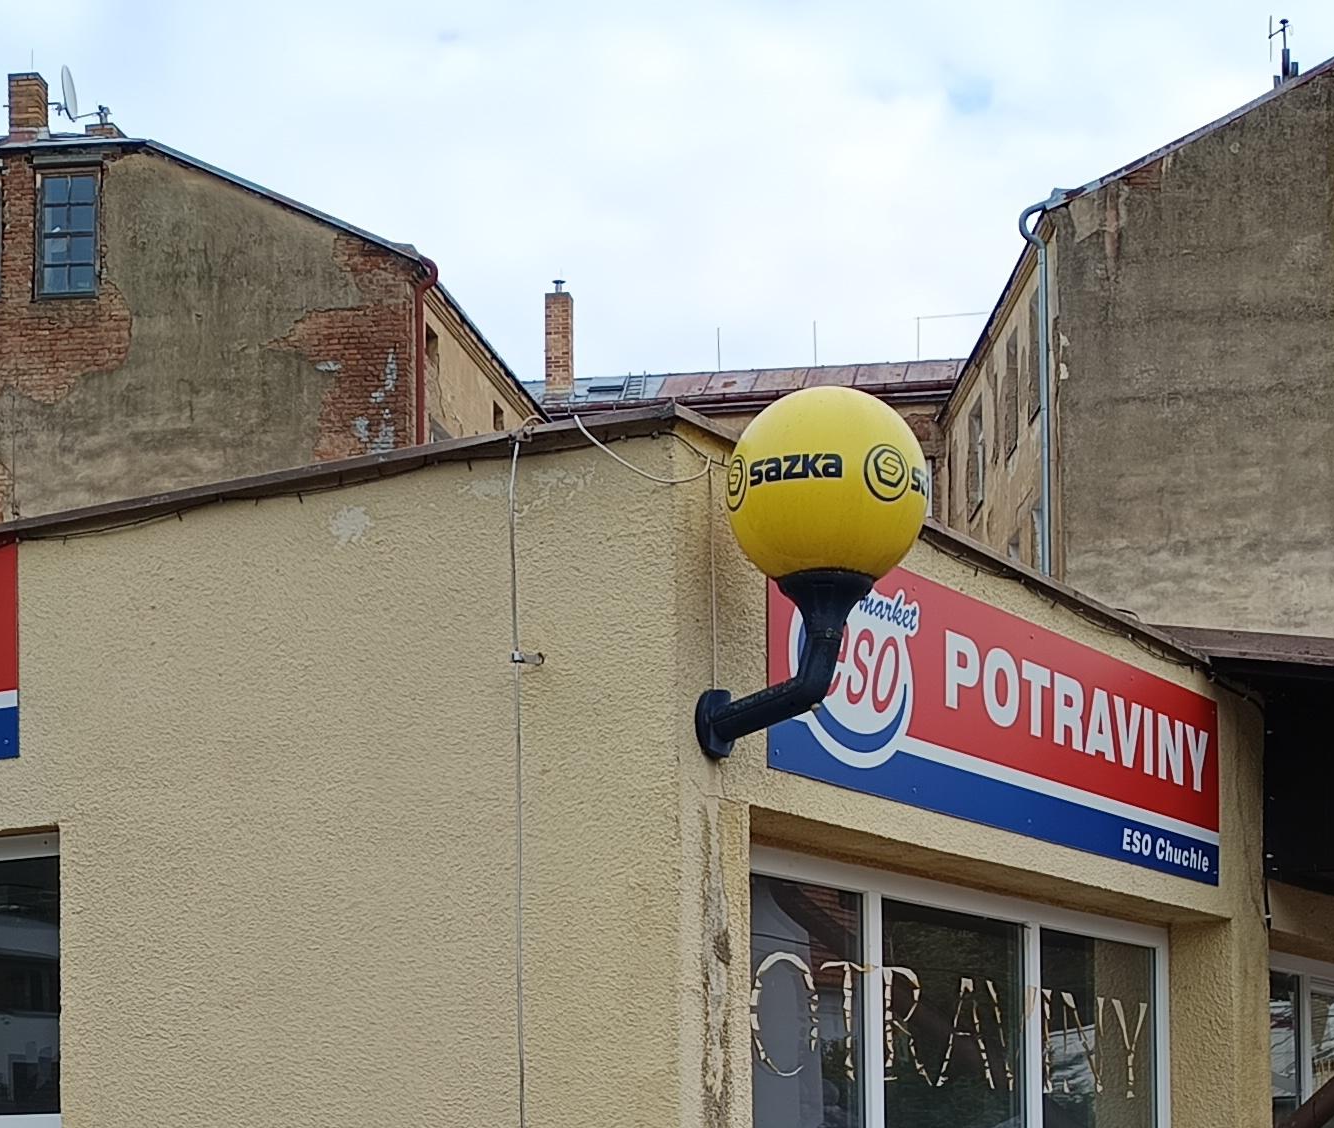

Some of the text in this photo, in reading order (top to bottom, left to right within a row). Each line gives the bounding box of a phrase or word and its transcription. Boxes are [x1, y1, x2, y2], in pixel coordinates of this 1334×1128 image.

[859, 594, 917, 630] market
[944, 629, 1209, 792] POTRAVINY
[1122, 828, 1209, 872] ESO Chuchle
[750, 952, 1148, 1098] OTRAVINY
